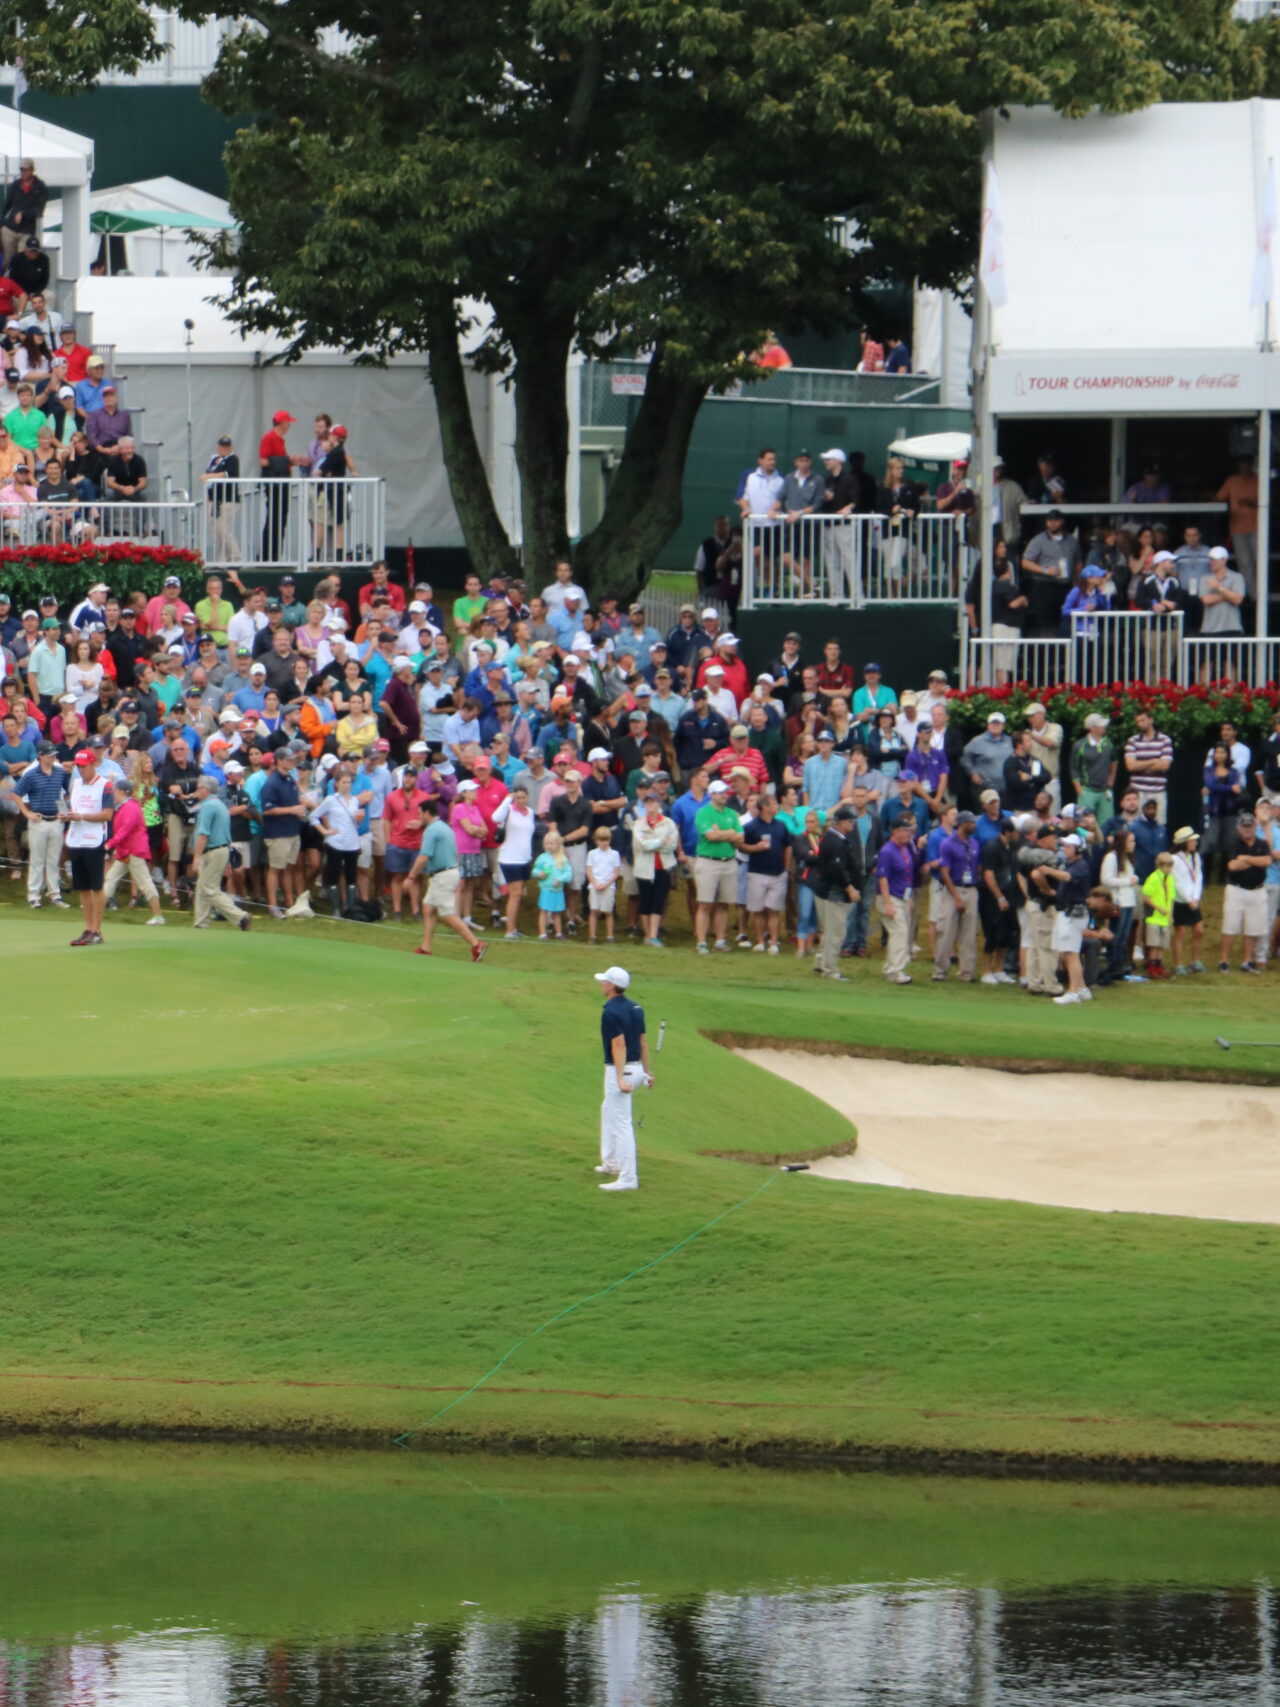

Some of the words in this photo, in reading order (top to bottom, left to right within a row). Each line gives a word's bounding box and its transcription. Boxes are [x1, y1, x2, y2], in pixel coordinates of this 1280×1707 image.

[1029, 376, 1069, 390] TOUR
[1074, 376, 1175, 390] CHAMPIONSHIP
[1179, 377, 1191, 391] by
